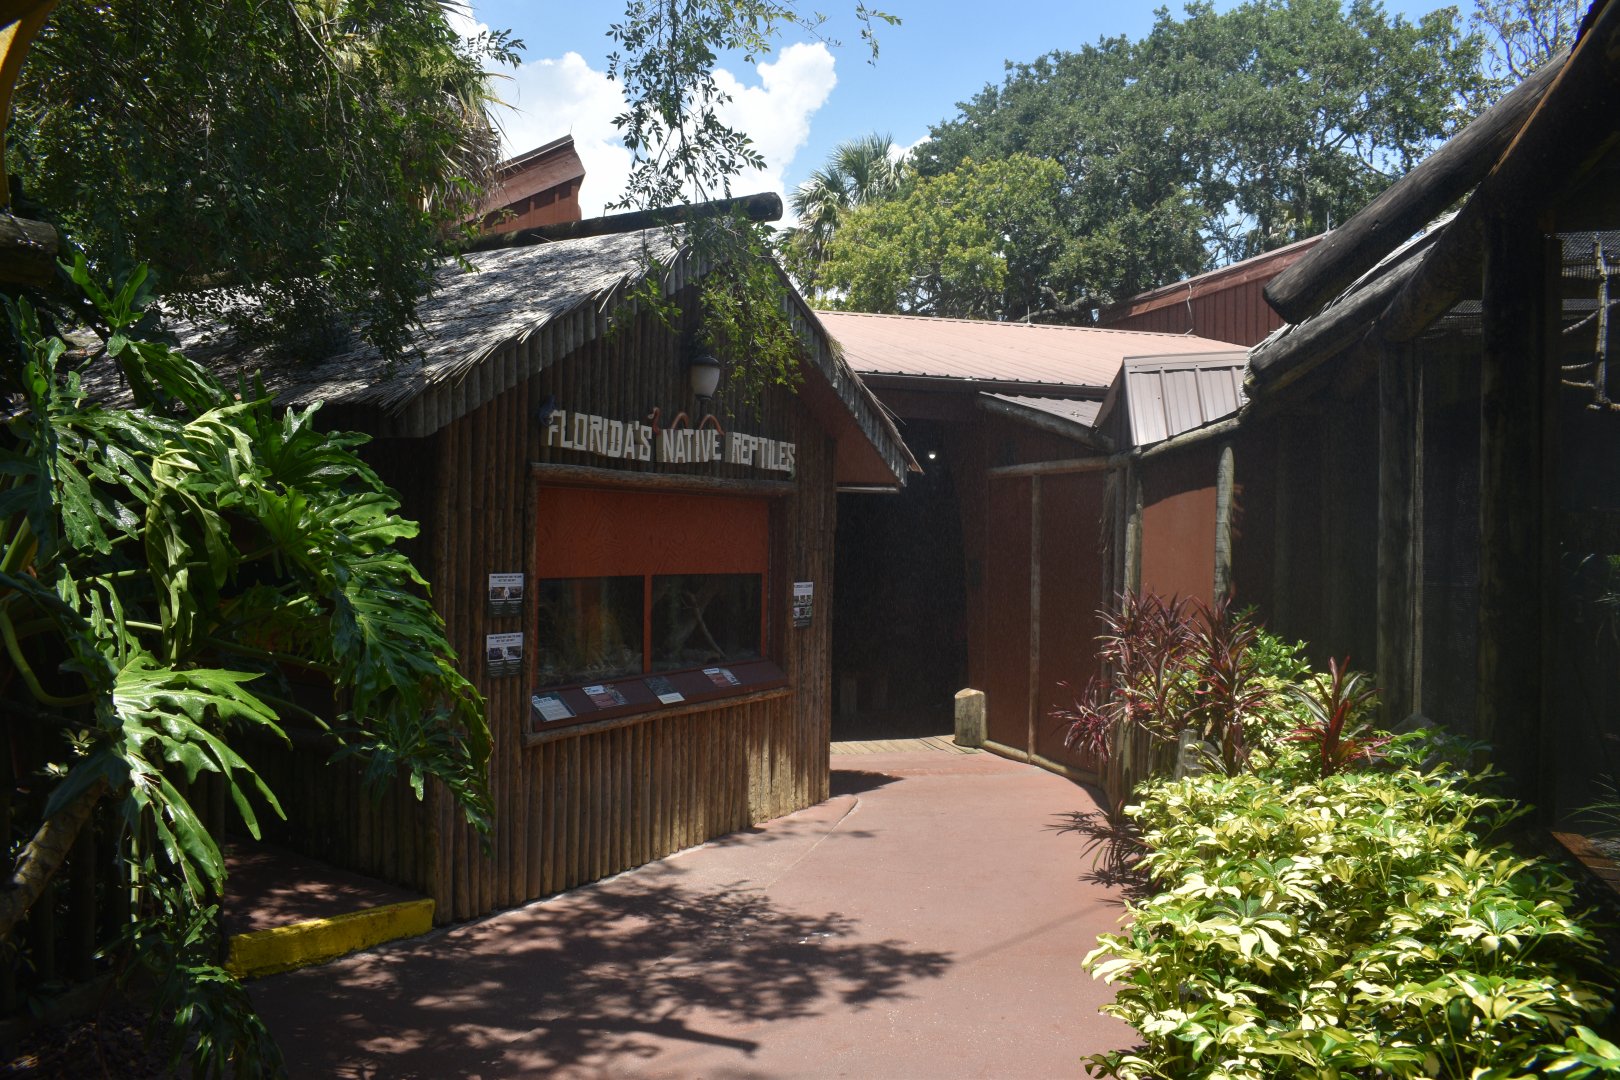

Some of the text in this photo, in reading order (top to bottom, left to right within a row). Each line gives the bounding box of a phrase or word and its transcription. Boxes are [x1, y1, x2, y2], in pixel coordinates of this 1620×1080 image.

[548, 409, 796, 472] FLORIDA'S NATIVE REPTILES
